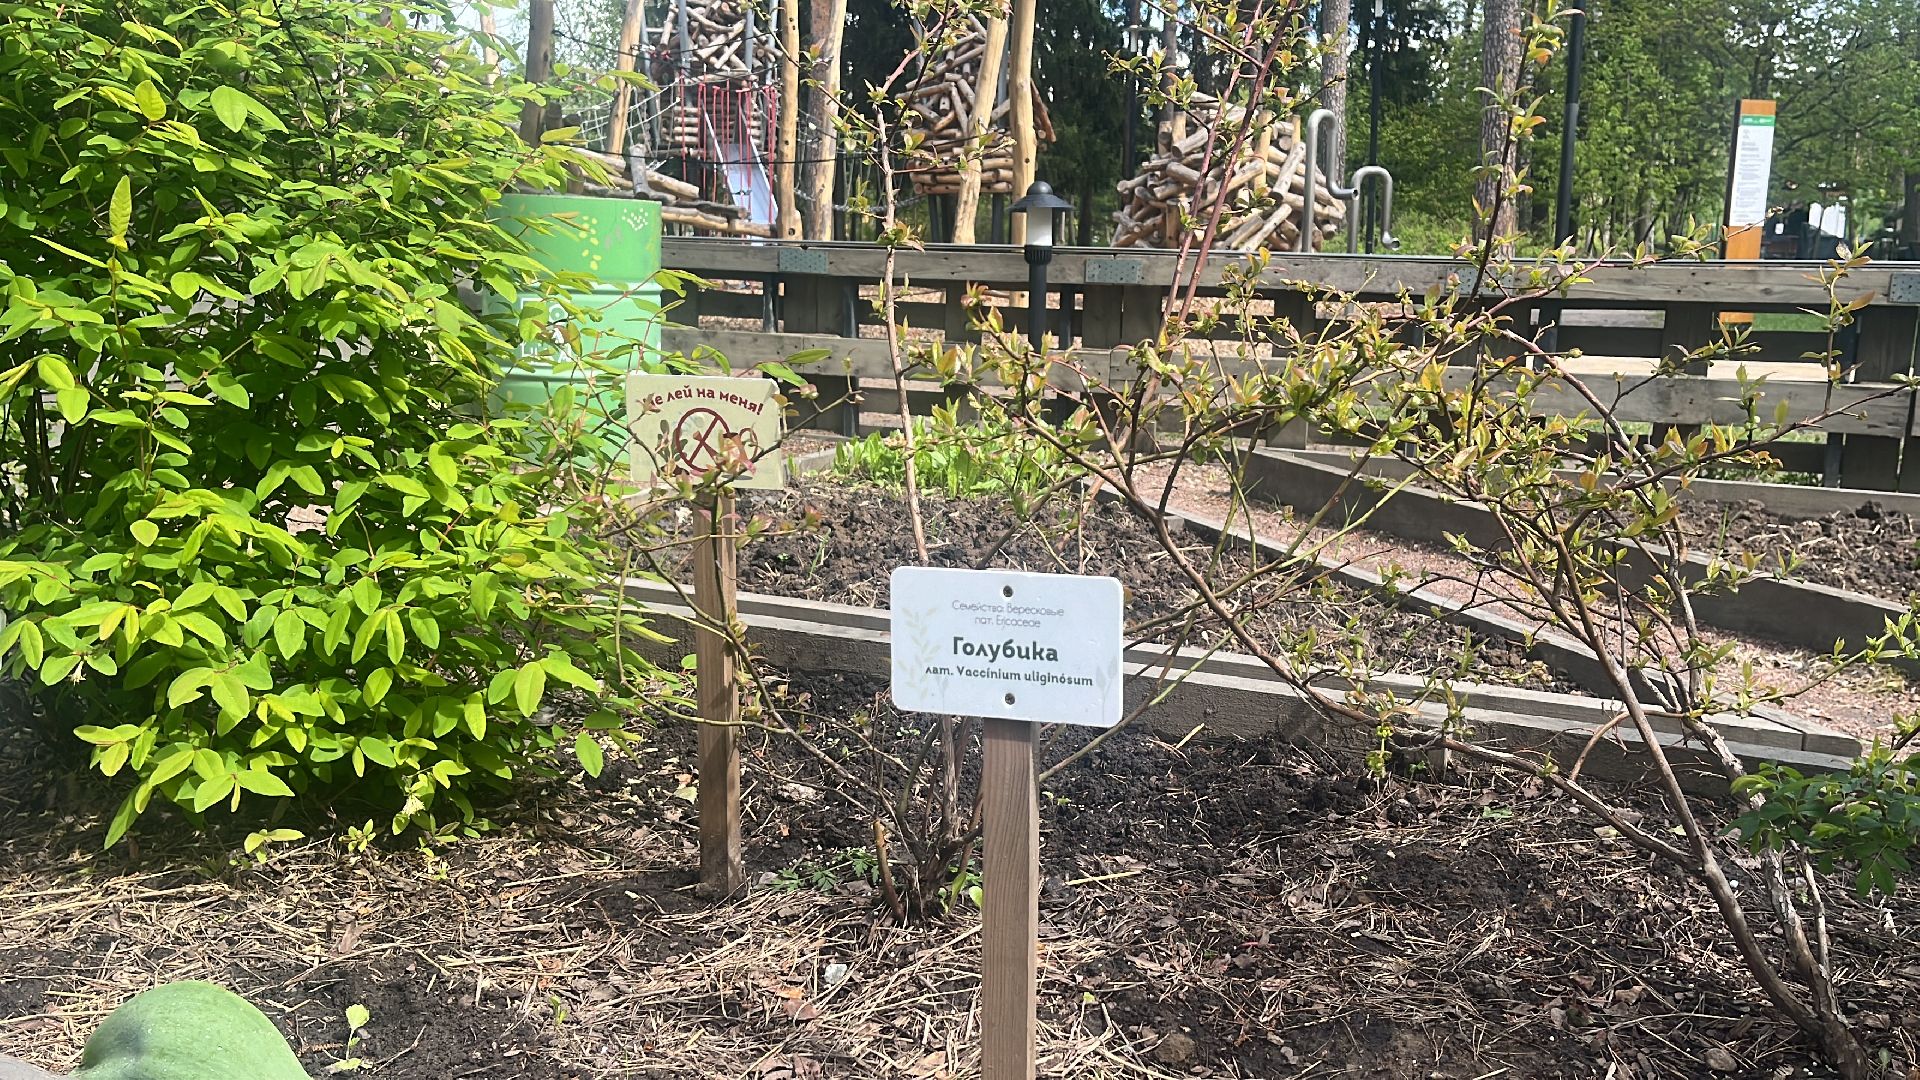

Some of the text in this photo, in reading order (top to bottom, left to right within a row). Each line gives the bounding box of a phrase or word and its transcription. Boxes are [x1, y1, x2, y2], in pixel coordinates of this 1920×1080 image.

[667, 385, 693, 402] лей
[696, 388, 715, 399] на
[719, 390, 764, 415] меня!
[1006, 602, 1065, 616] Вересковые
[953, 636, 1059, 663] Голубика
[925, 666, 954, 676] лат.
